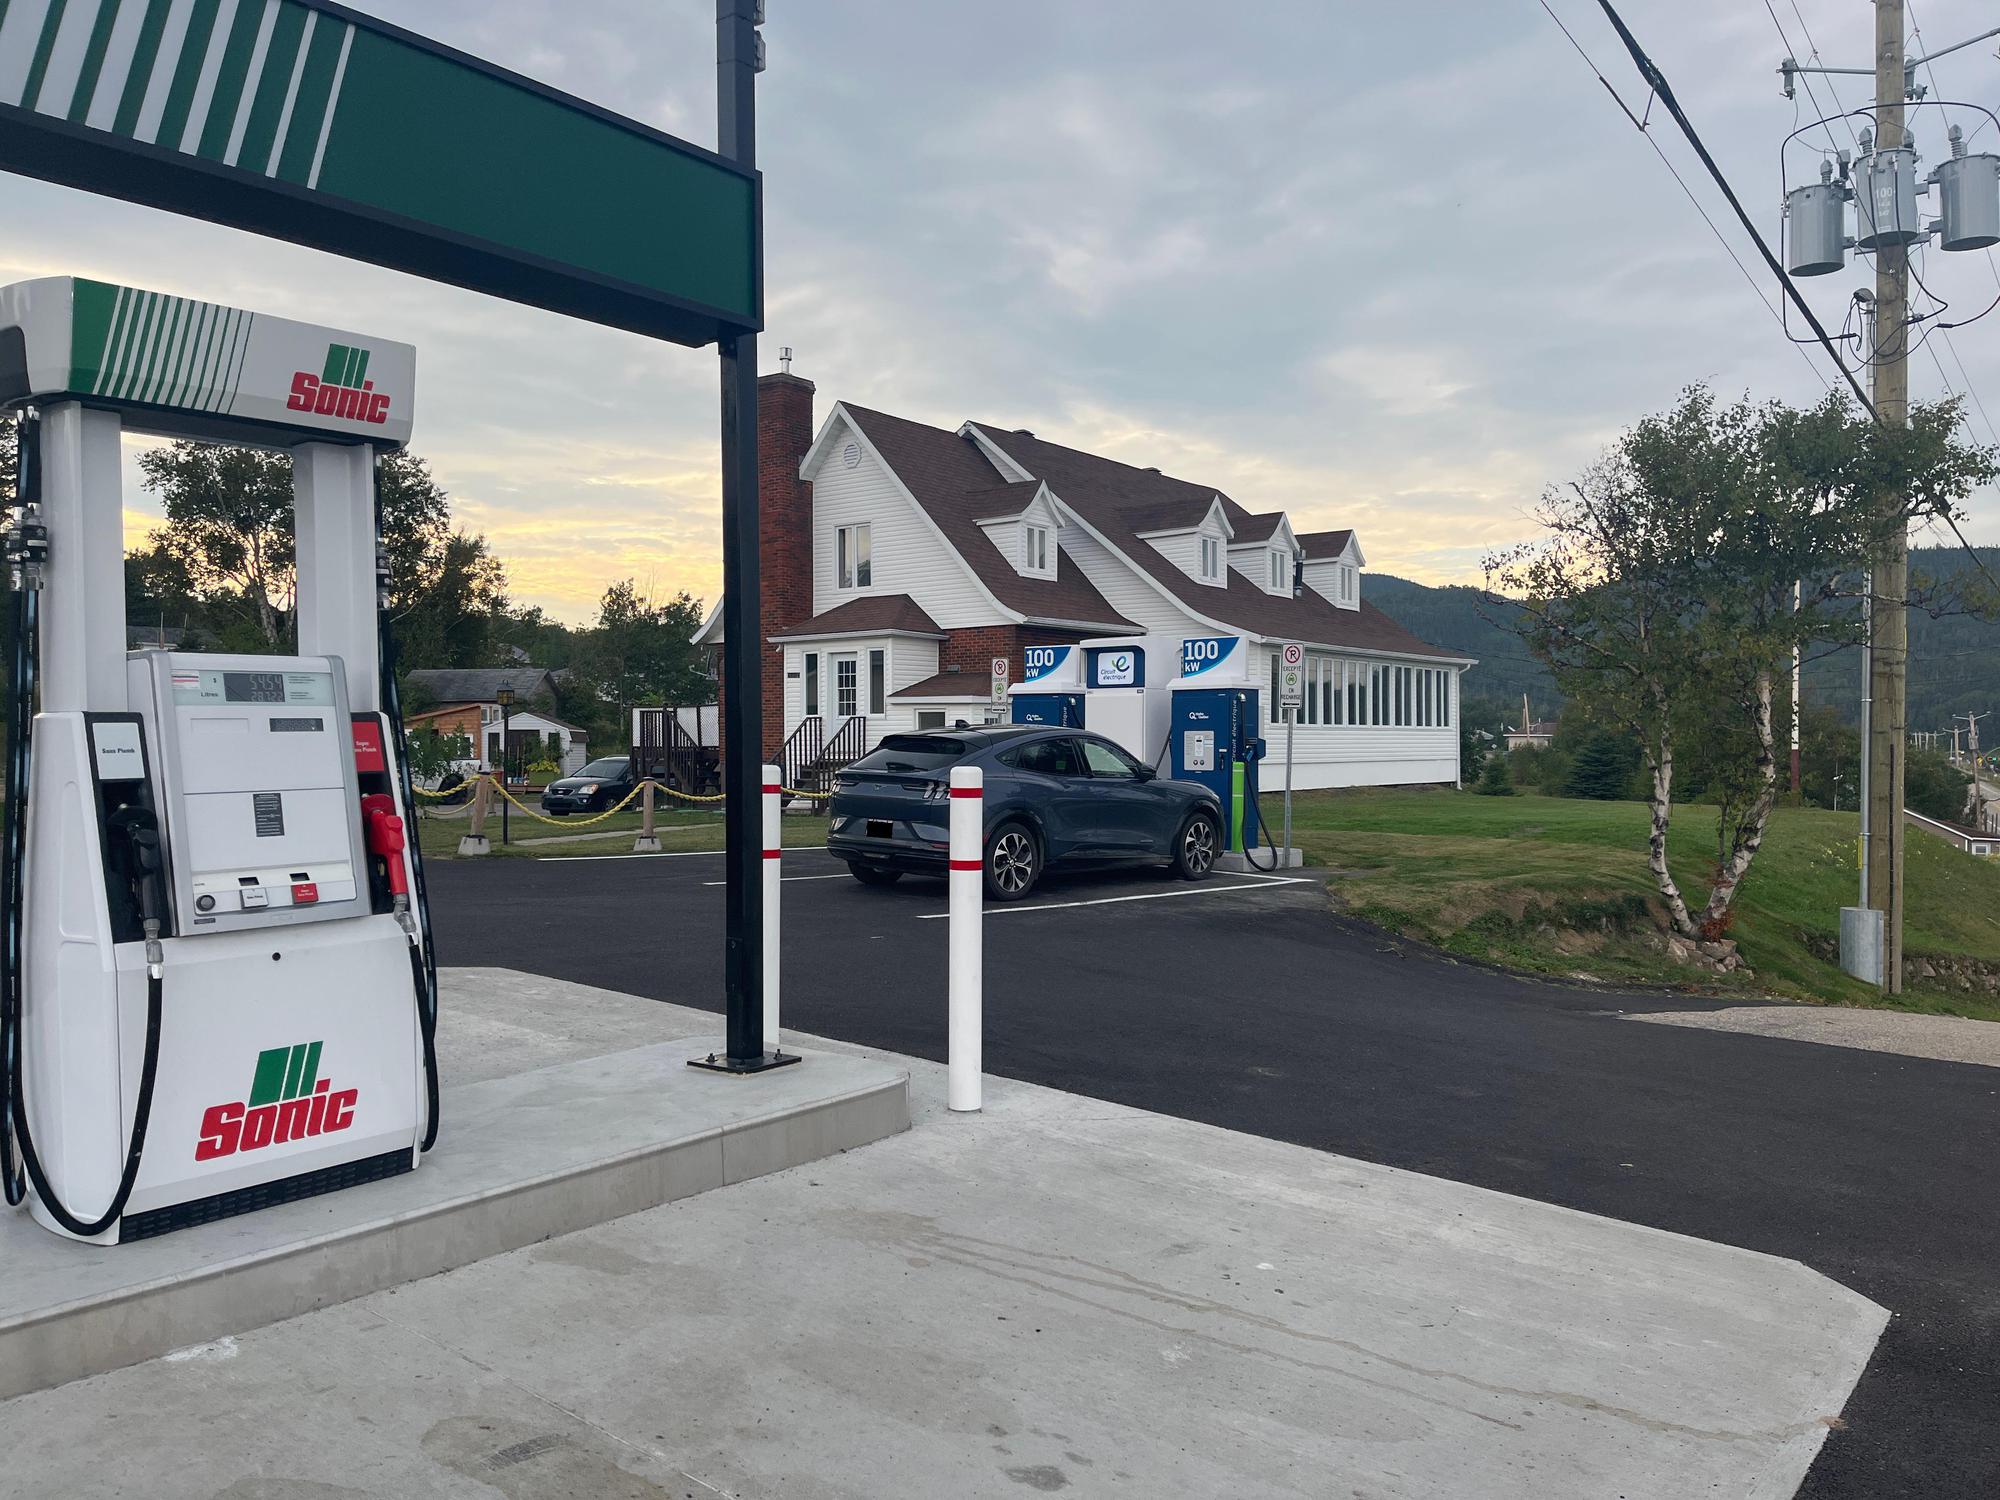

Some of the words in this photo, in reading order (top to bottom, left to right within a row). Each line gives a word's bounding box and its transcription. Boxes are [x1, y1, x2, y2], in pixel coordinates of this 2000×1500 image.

[286, 371, 391, 424] Sonic
[1026, 649, 1055, 667] 100
[1185, 641, 1219, 661] 100
[1026, 668, 1040, 678] kW
[1185, 662, 1200, 672] kW
[195, 1078, 359, 1162] Sonic
